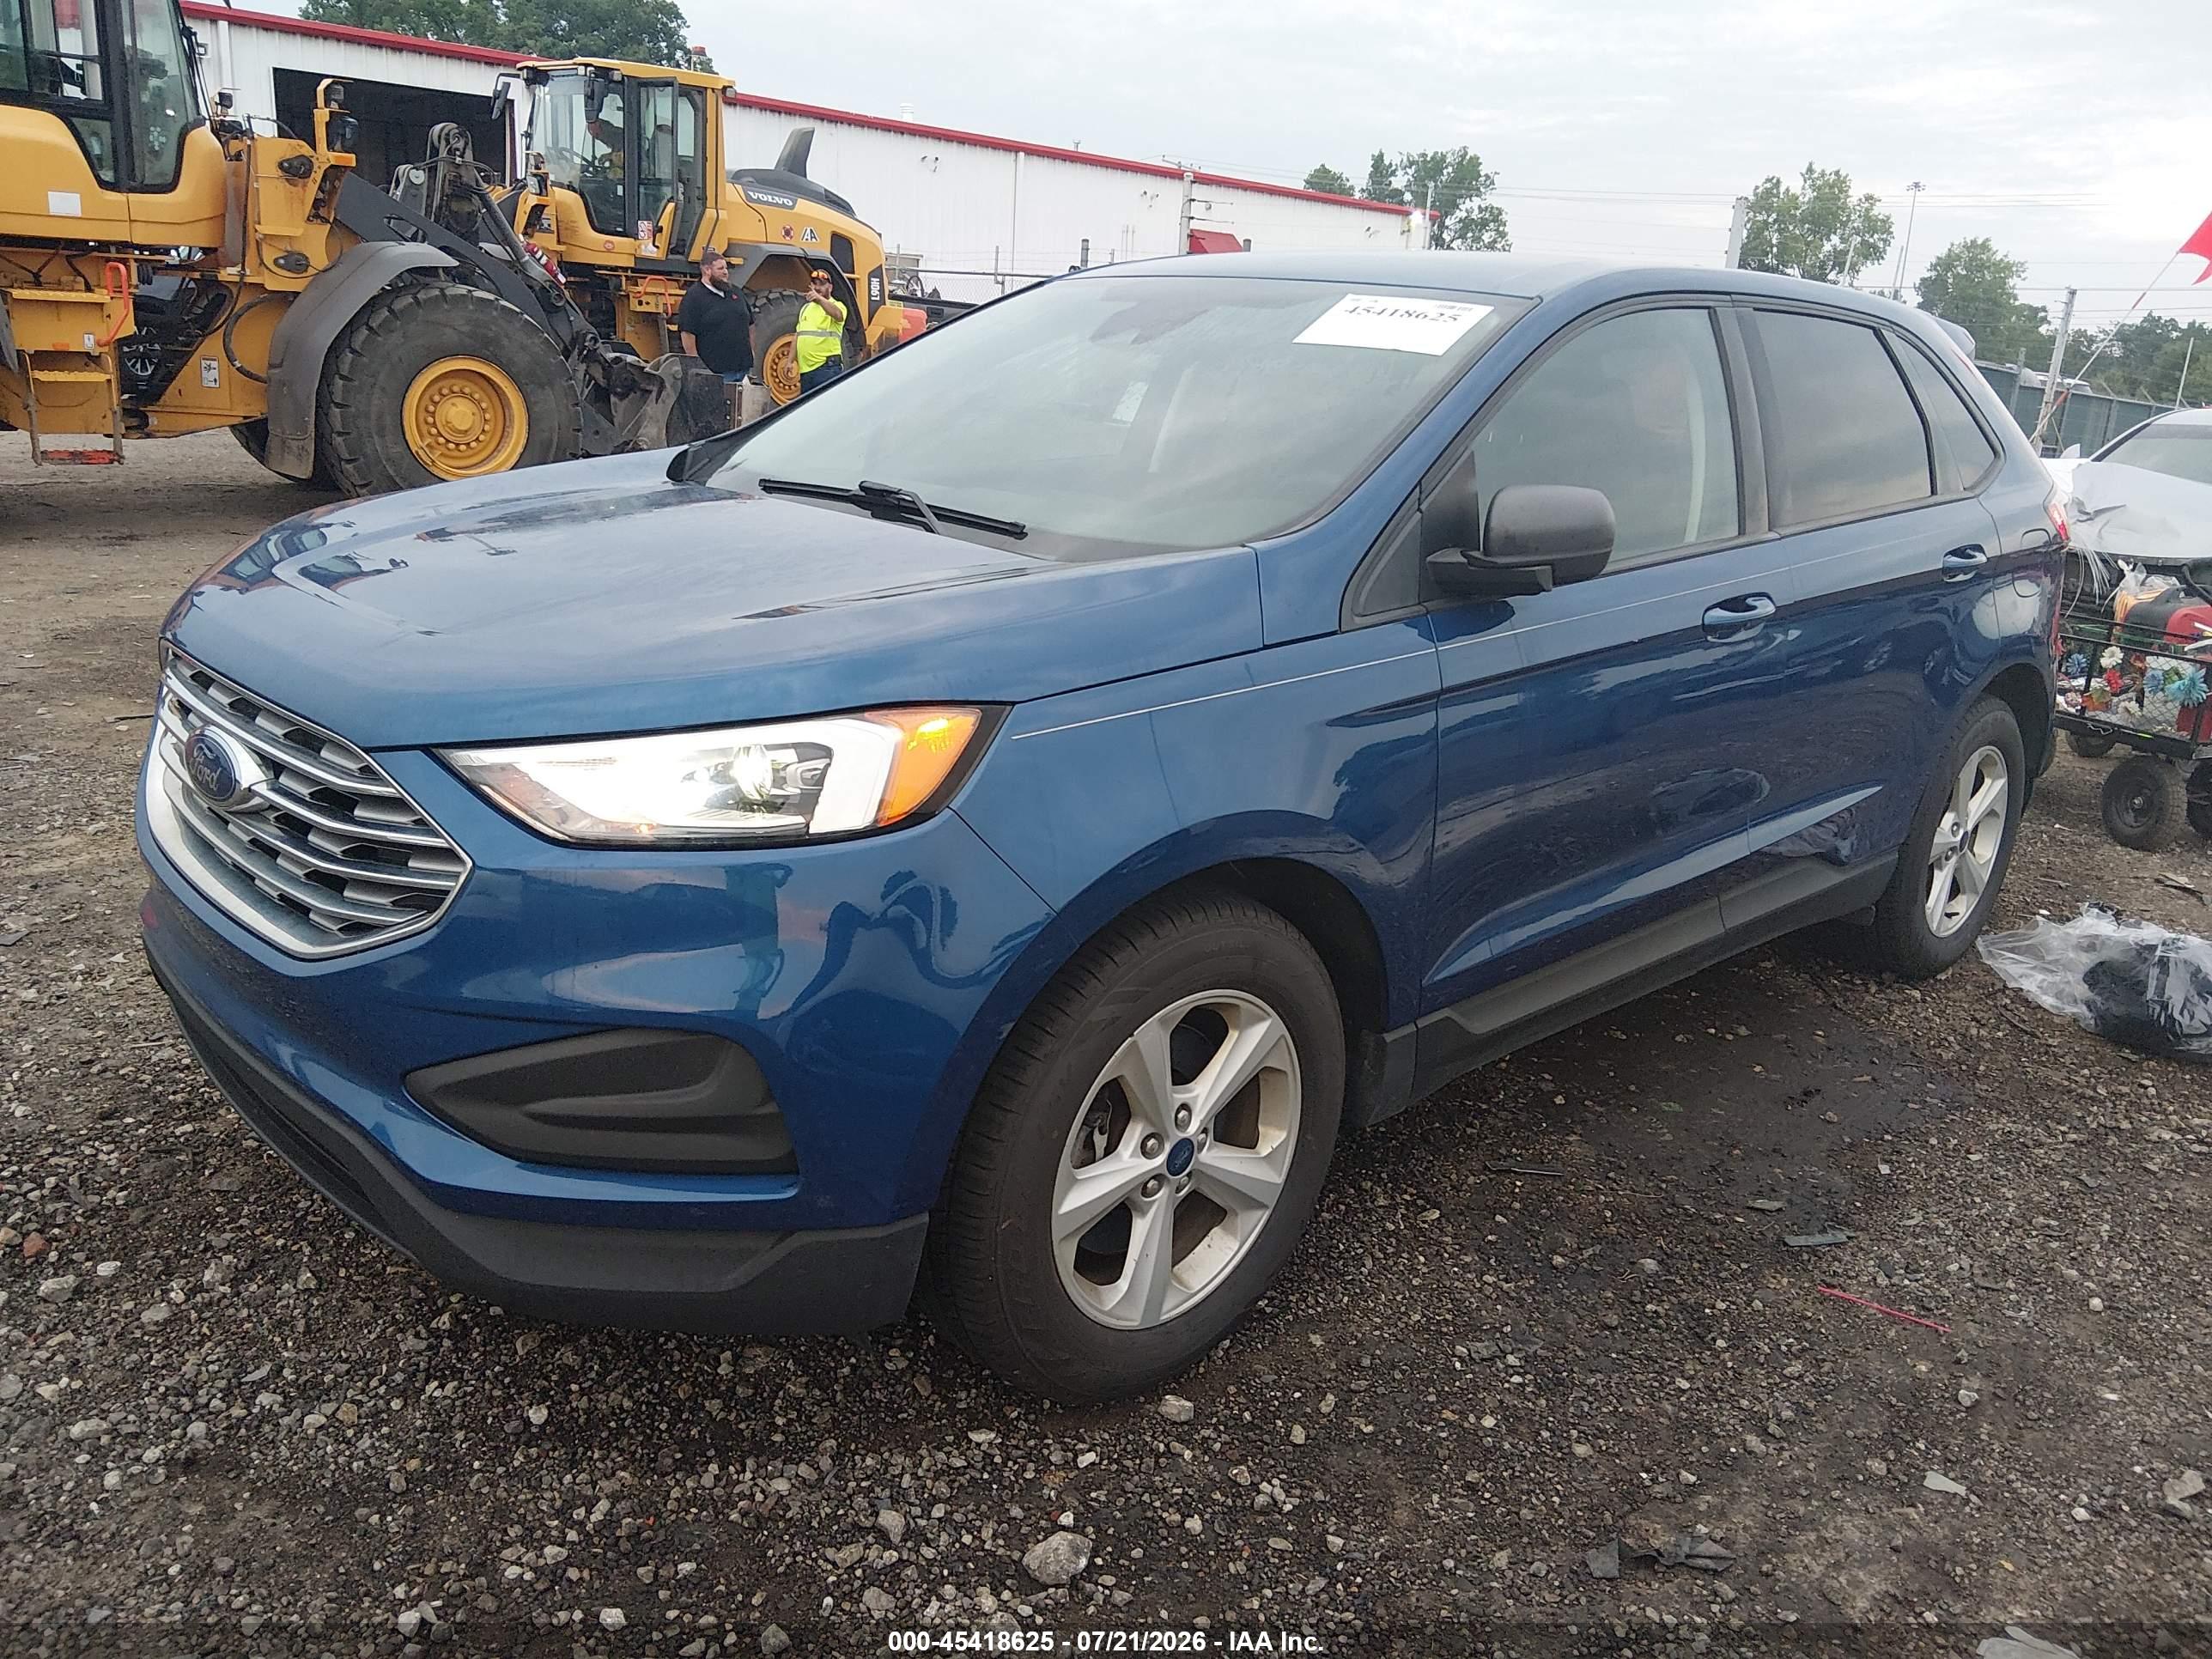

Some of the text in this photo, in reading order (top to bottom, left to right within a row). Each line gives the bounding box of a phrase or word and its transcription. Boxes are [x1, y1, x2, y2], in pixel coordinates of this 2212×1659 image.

[747, 191, 793, 206] VOLVO
[870, 276, 880, 301] L90H
[1344, 306, 1462, 323] 45418625
[189, 743, 221, 791] Ford
